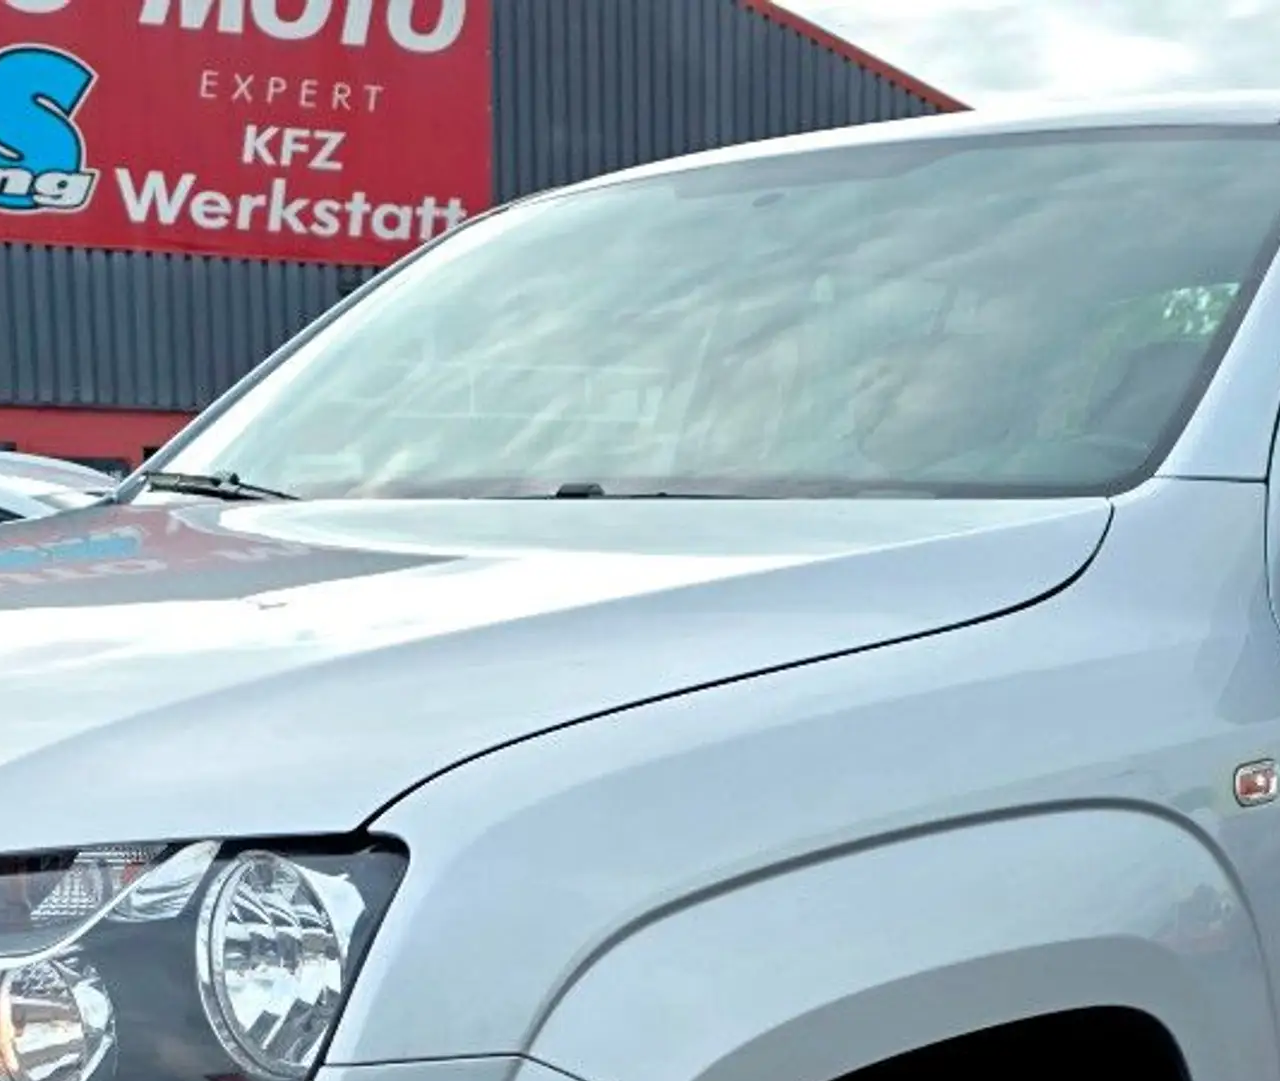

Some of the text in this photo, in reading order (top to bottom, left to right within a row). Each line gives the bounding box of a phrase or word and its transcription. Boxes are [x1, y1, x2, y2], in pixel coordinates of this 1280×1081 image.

[200, 70, 384, 112] EXPERT
[241, 124, 346, 170] KFZ
[115, 167, 467, 240] Werkstatt
